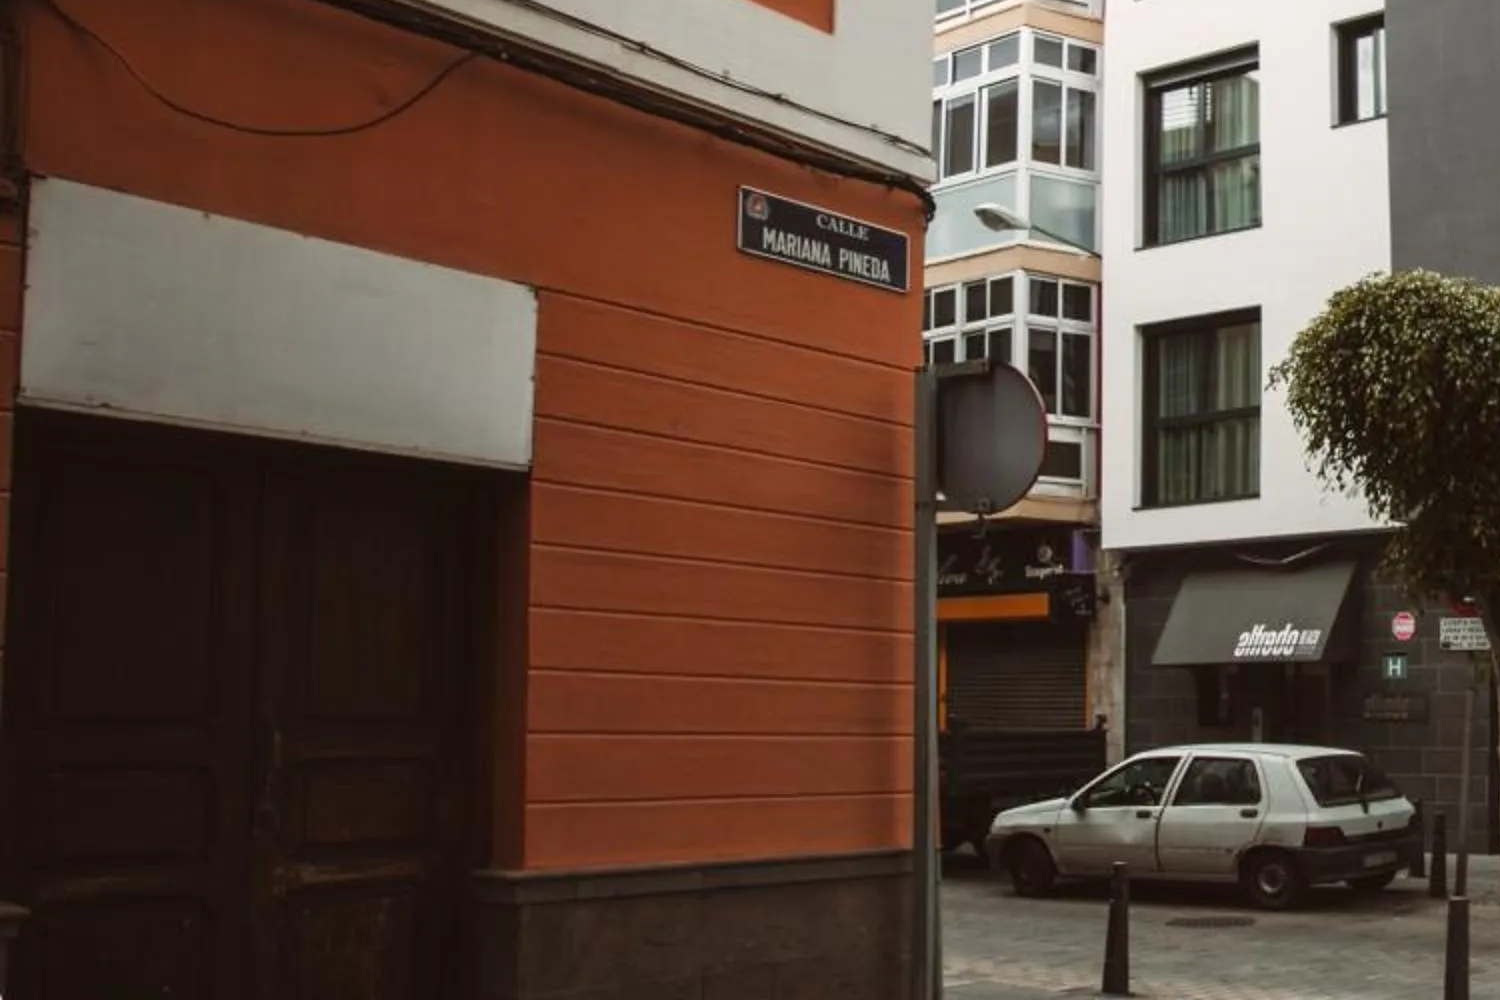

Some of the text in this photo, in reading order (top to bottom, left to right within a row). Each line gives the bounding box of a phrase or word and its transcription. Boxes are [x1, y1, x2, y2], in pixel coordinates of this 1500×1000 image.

[816, 213, 868, 241] CALLE
[762, 227, 891, 283] MARIANA PINEDA
[1387, 657, 1402, 677] H
